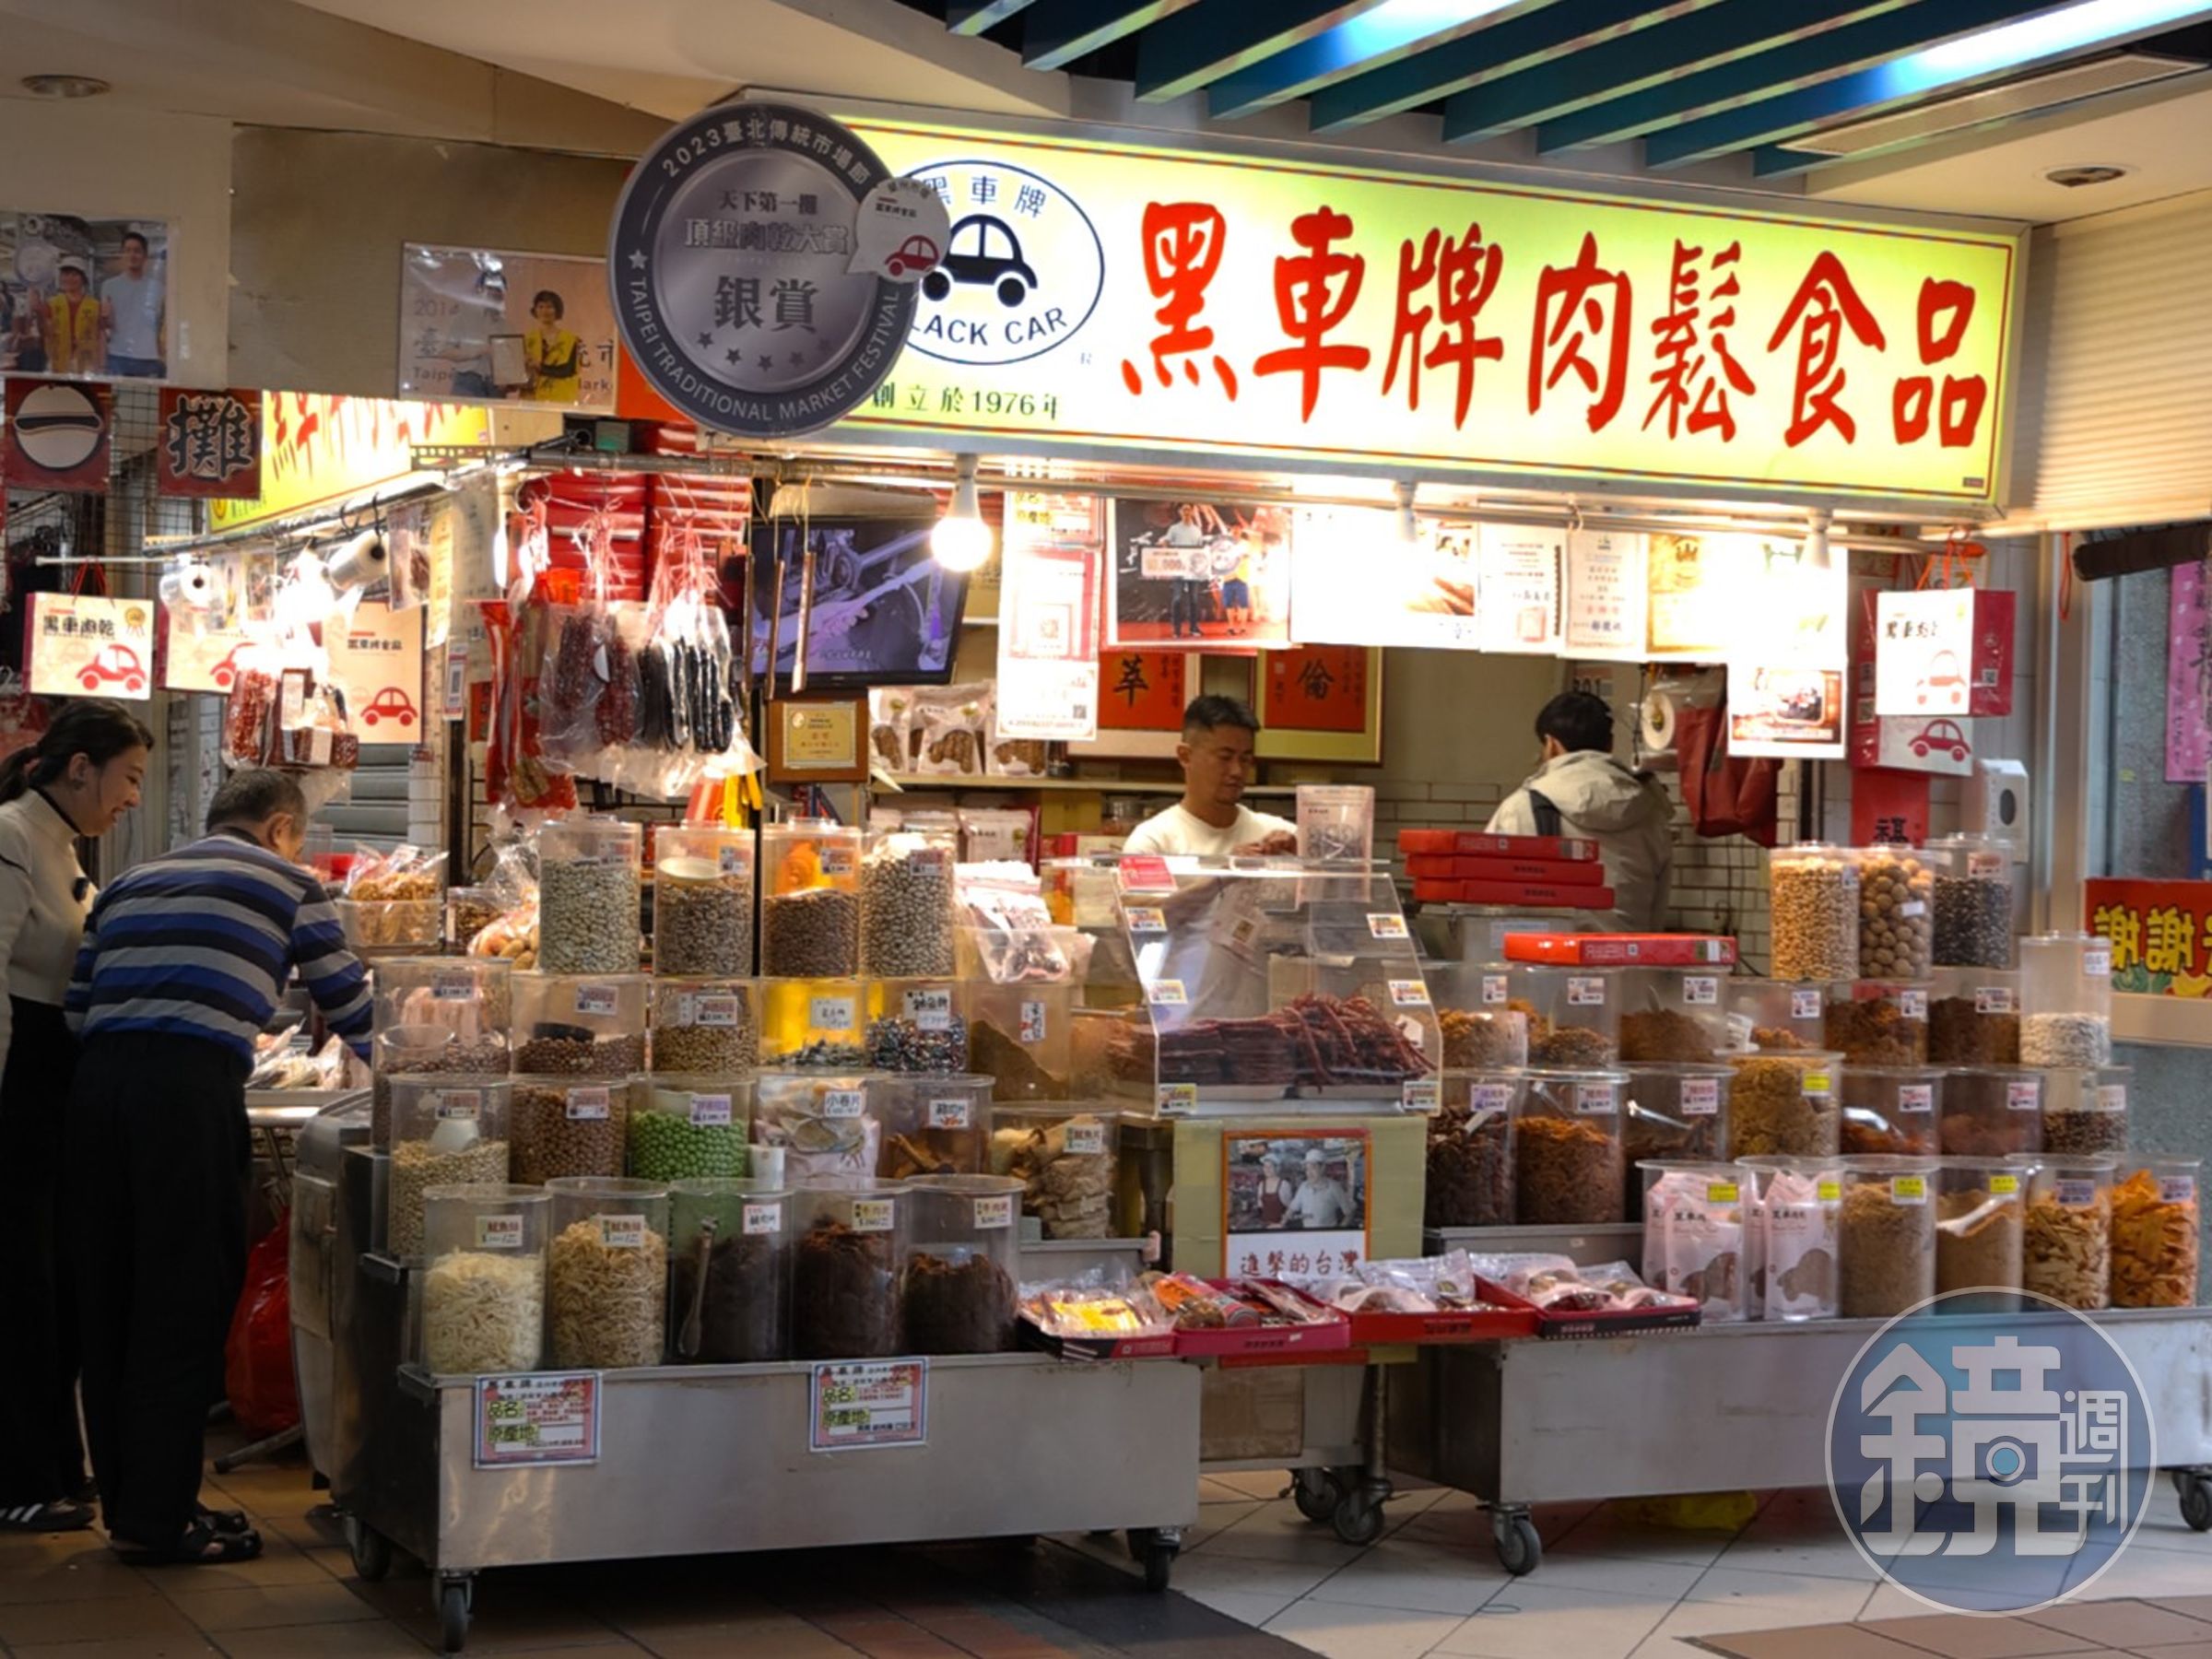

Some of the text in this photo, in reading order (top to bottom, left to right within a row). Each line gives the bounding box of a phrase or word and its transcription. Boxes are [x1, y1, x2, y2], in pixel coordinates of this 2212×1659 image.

[714, 276, 819, 333] 銀賞
[911, 307, 1067, 347] ACK CAR
[1122, 201, 1987, 449] 黑車牌肉鬆食品
[629, 278, 900, 421] TAIPEI TRADITIONAL MARKET FESTIVAL
[169, 395, 253, 478] 攤
[2093, 904, 2212, 974] 謝謝
[1240, 1249, 1359, 1278] 進擊的台灣
